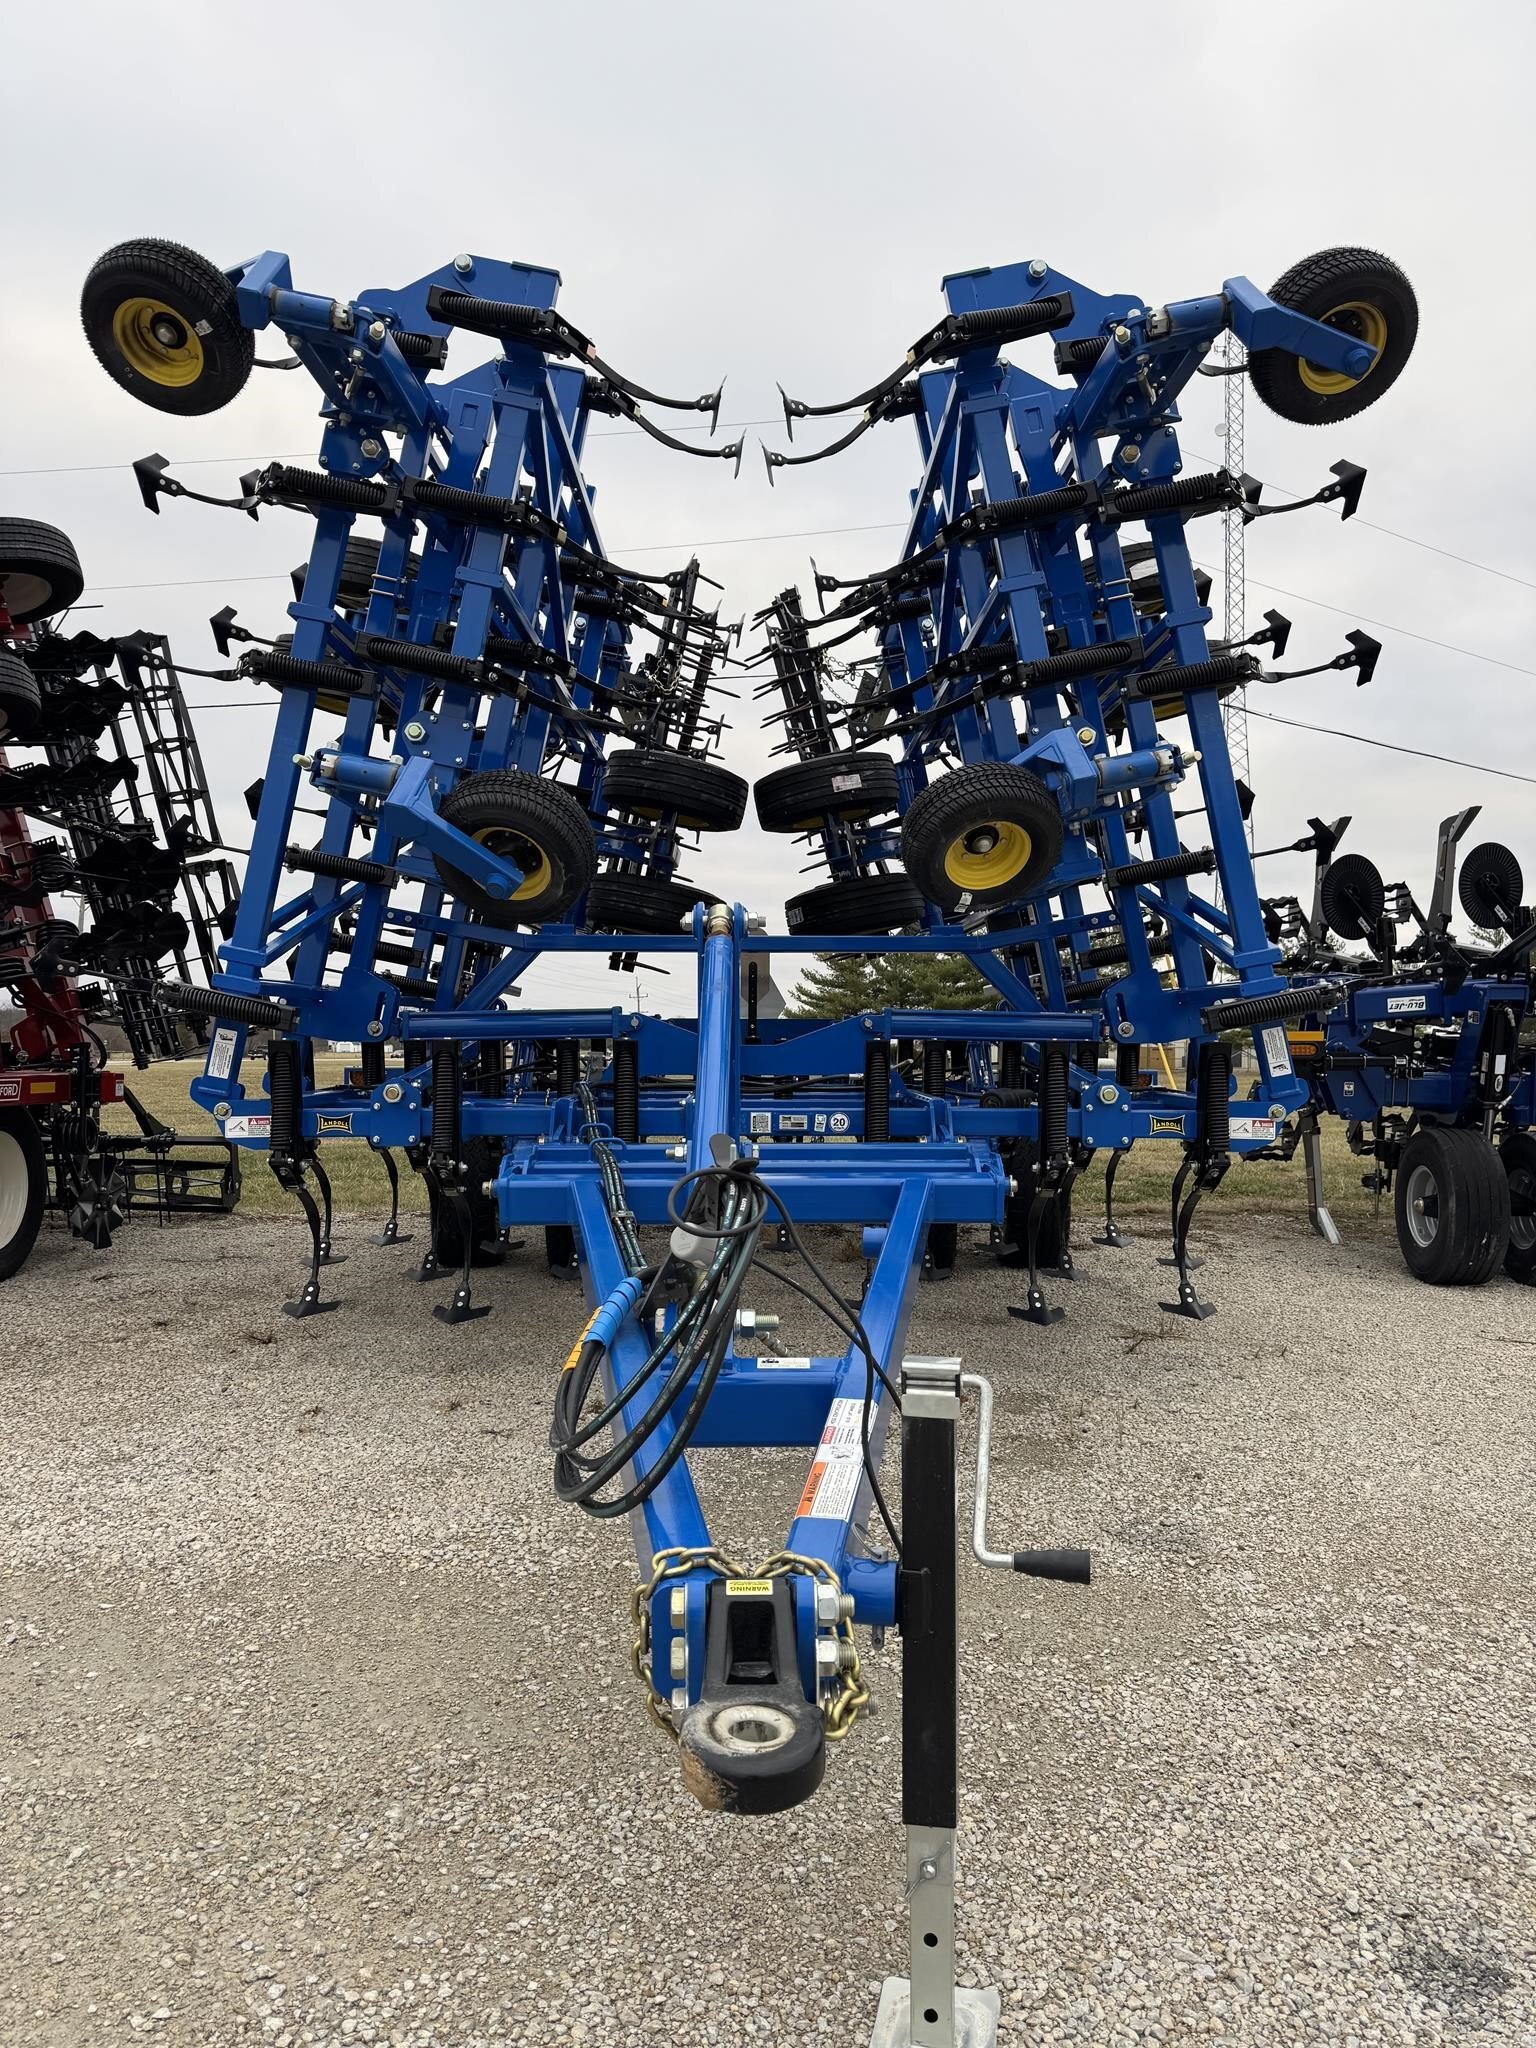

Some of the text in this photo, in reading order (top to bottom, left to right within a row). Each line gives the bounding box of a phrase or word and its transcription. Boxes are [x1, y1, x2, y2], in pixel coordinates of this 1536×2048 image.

[320, 1117, 349, 1130] LANDOLL
[833, 1117, 846, 1127] 20
[1153, 1118, 1181, 1131] LANDOLL
[693, 1329, 709, 1351] GATES
